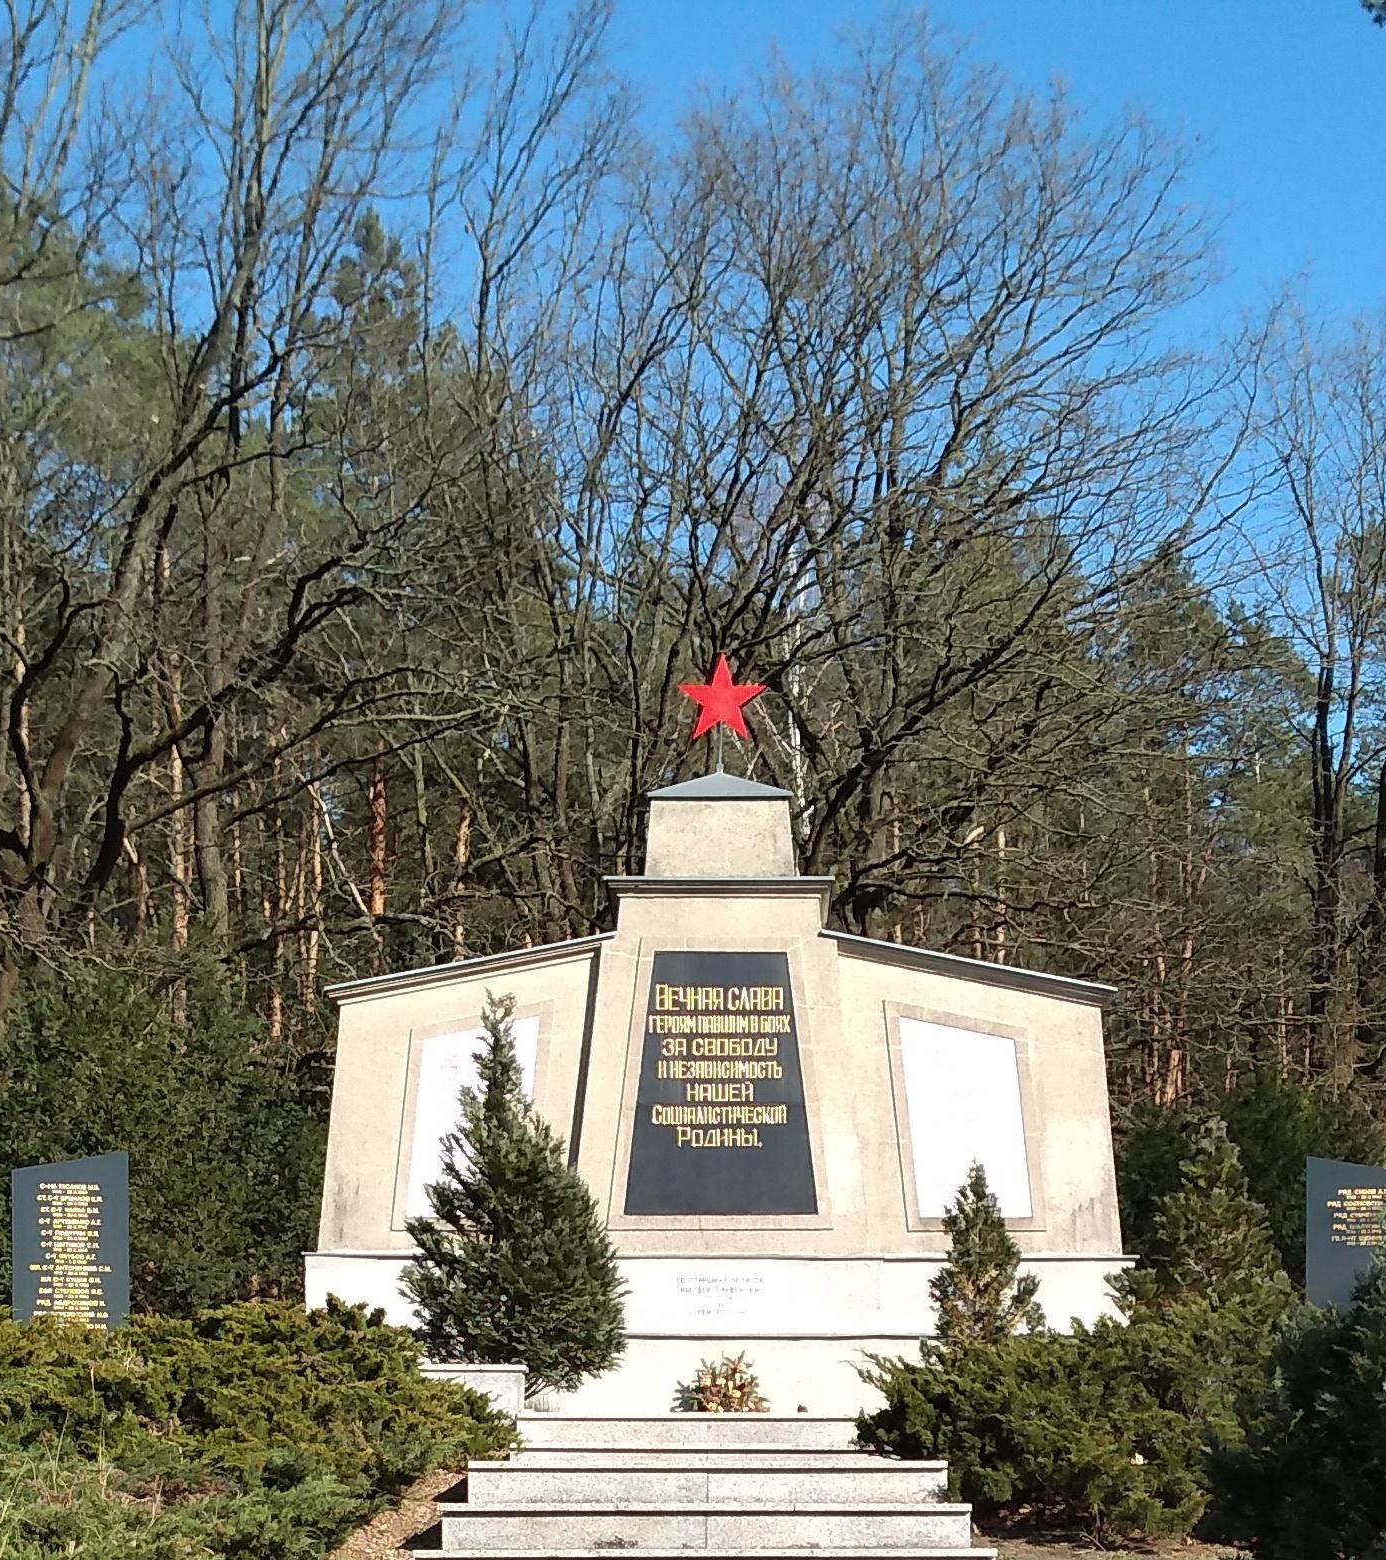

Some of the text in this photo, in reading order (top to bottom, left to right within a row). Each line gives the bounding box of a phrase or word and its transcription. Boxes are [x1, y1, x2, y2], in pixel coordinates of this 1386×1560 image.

[655, 983, 784, 1011] ВЕЧНАЯ СЛАВА
[648, 1015, 791, 1034] ГЕРОЯМ ПАВШИМ В БОЯХ
[661, 1037, 778, 1057] ЗА СВОБОДУ
[658, 1060, 783, 1079] И НЕЗАВИСИМОСТЬ
[686, 1081, 754, 1102] НАШЕЙ
